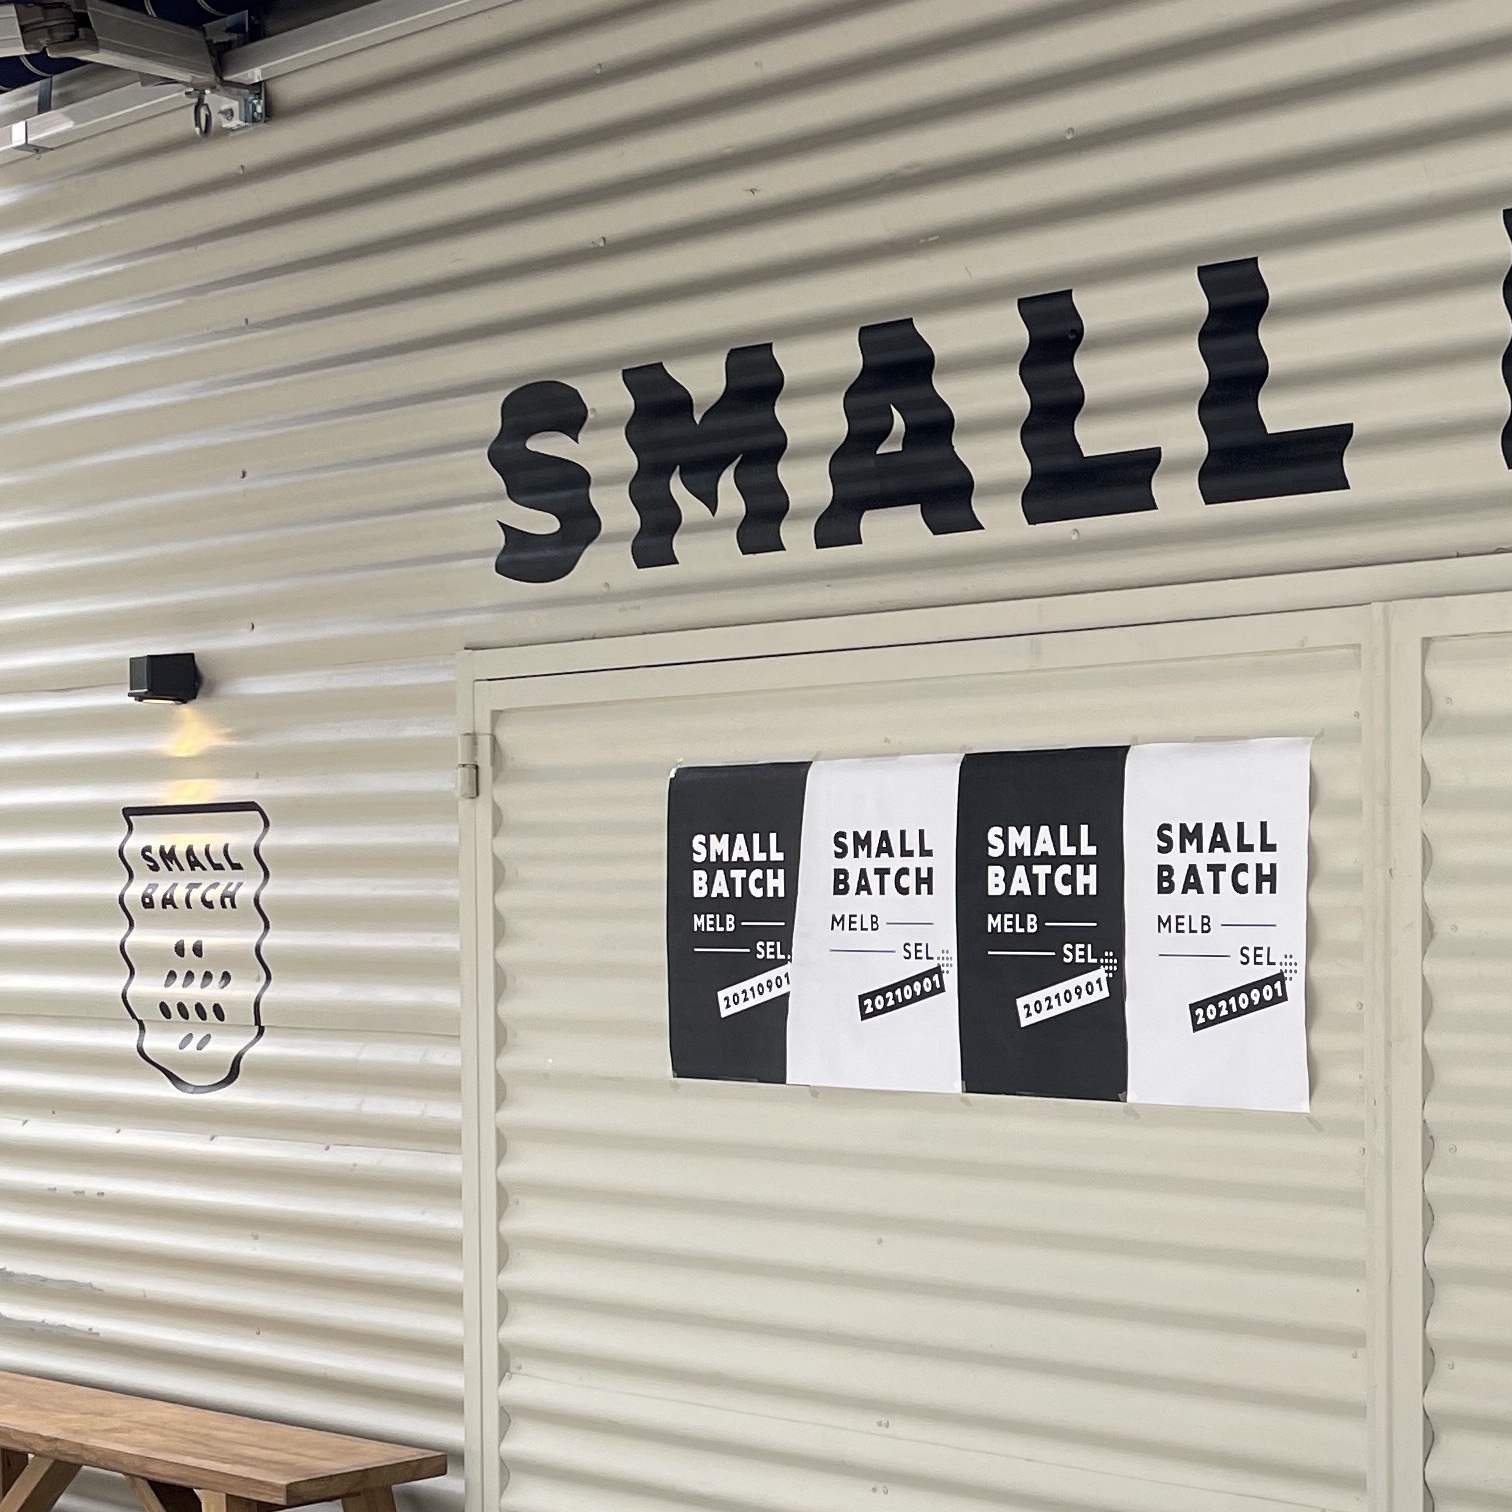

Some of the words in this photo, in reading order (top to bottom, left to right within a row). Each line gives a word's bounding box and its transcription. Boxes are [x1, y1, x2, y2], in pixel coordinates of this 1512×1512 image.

[488, 257, 1353, 584] SMALL
[693, 833, 784, 862] SMALL
[834, 829, 933, 859] SMALL
[988, 825, 1096, 857] SMALL
[1157, 821, 1277, 854] SMALL
[141, 843, 244, 872] SMALL
[693, 869, 784, 897] BATCH
[833, 867, 933, 895] BATCH
[988, 865, 1096, 895] BATCH
[1157, 863, 1276, 894] BATCH
[141, 882, 243, 909] BATCH
[694, 914, 735, 931] MELB
[831, 914, 879, 931] MELB
[988, 914, 1037, 932] MELB
[1158, 915, 1211, 933] MELB
[756, 941, 786, 960] SEL
[903, 943, 934, 961] SEL
[1063, 943, 1097, 964] SEL
[1240, 946, 1276, 966] SEL
[723, 972, 790, 1009] 20210901
[863, 973, 941, 1014] 20210901
[1023, 977, 1105, 1018] 20210901
[1194, 980, 1283, 1025] 20210901
